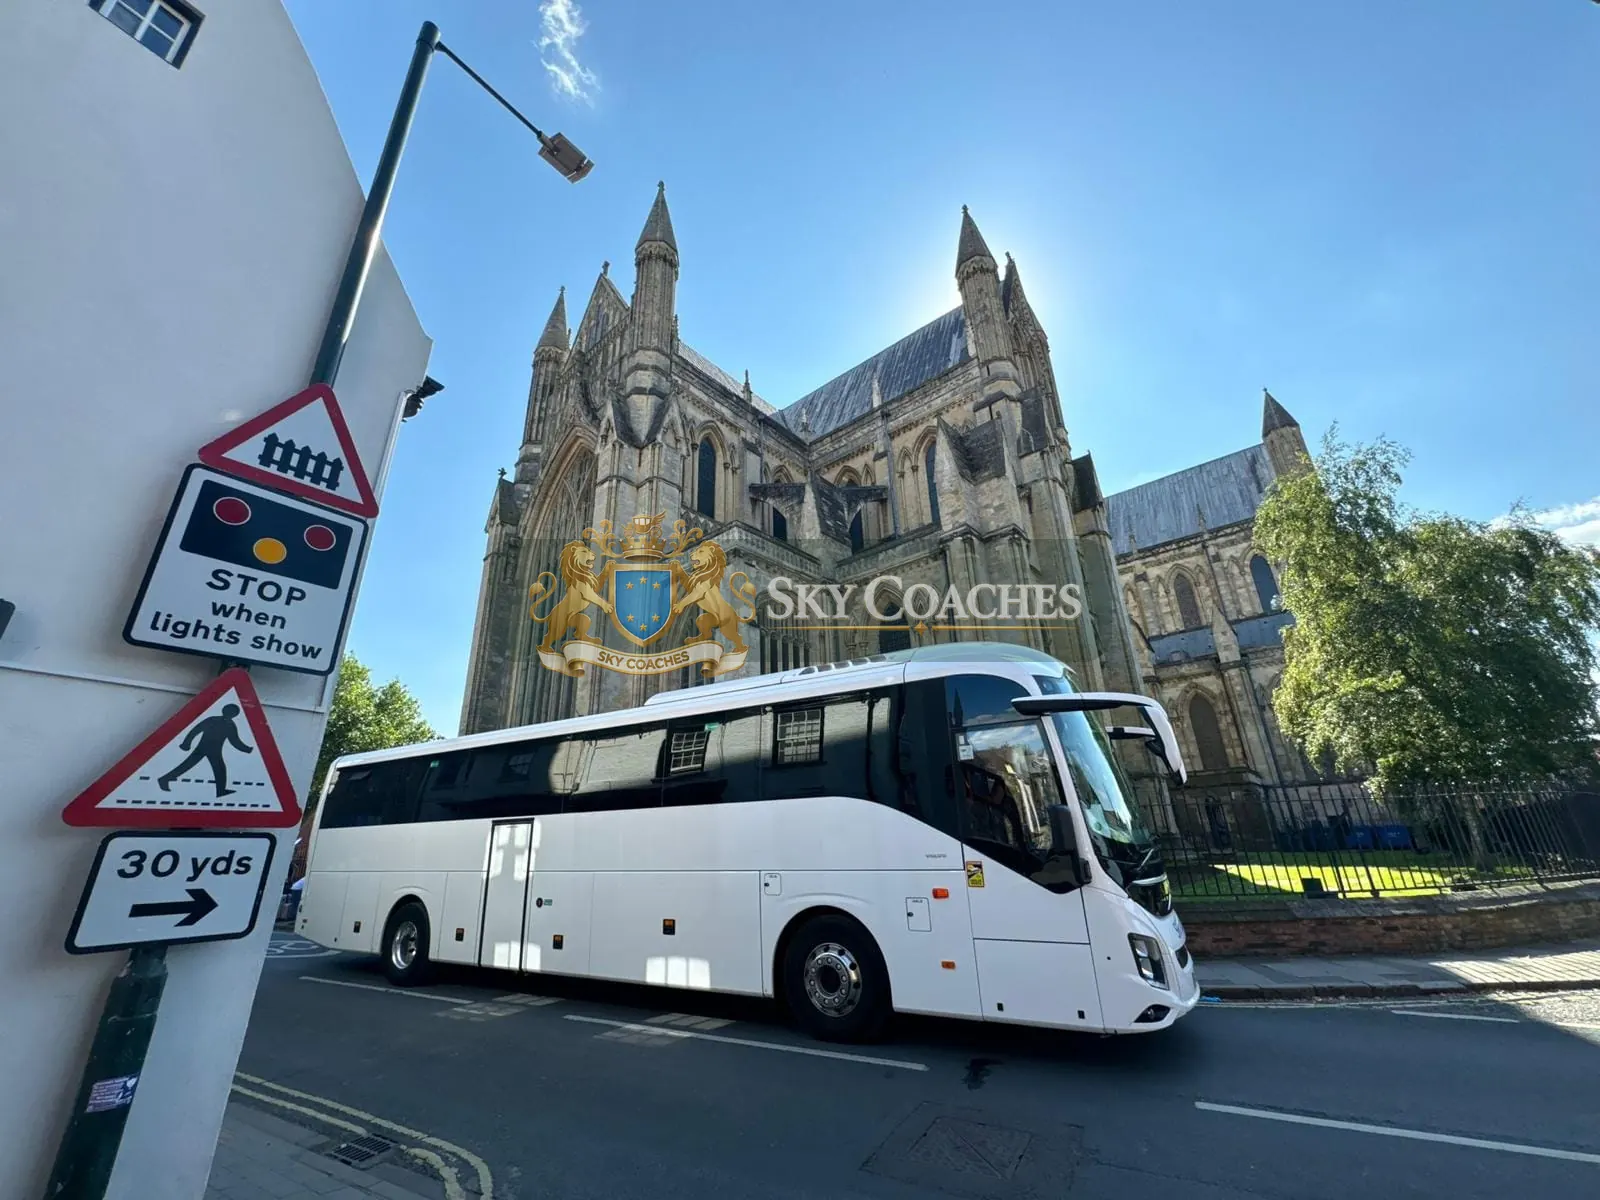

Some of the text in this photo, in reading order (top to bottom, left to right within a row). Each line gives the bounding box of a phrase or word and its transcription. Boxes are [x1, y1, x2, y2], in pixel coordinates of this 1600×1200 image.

[206, 568, 307, 606] STOP
[211, 601, 286, 629] when
[150, 611, 323, 660] lights show
[116, 849, 254, 882] 30 yds
